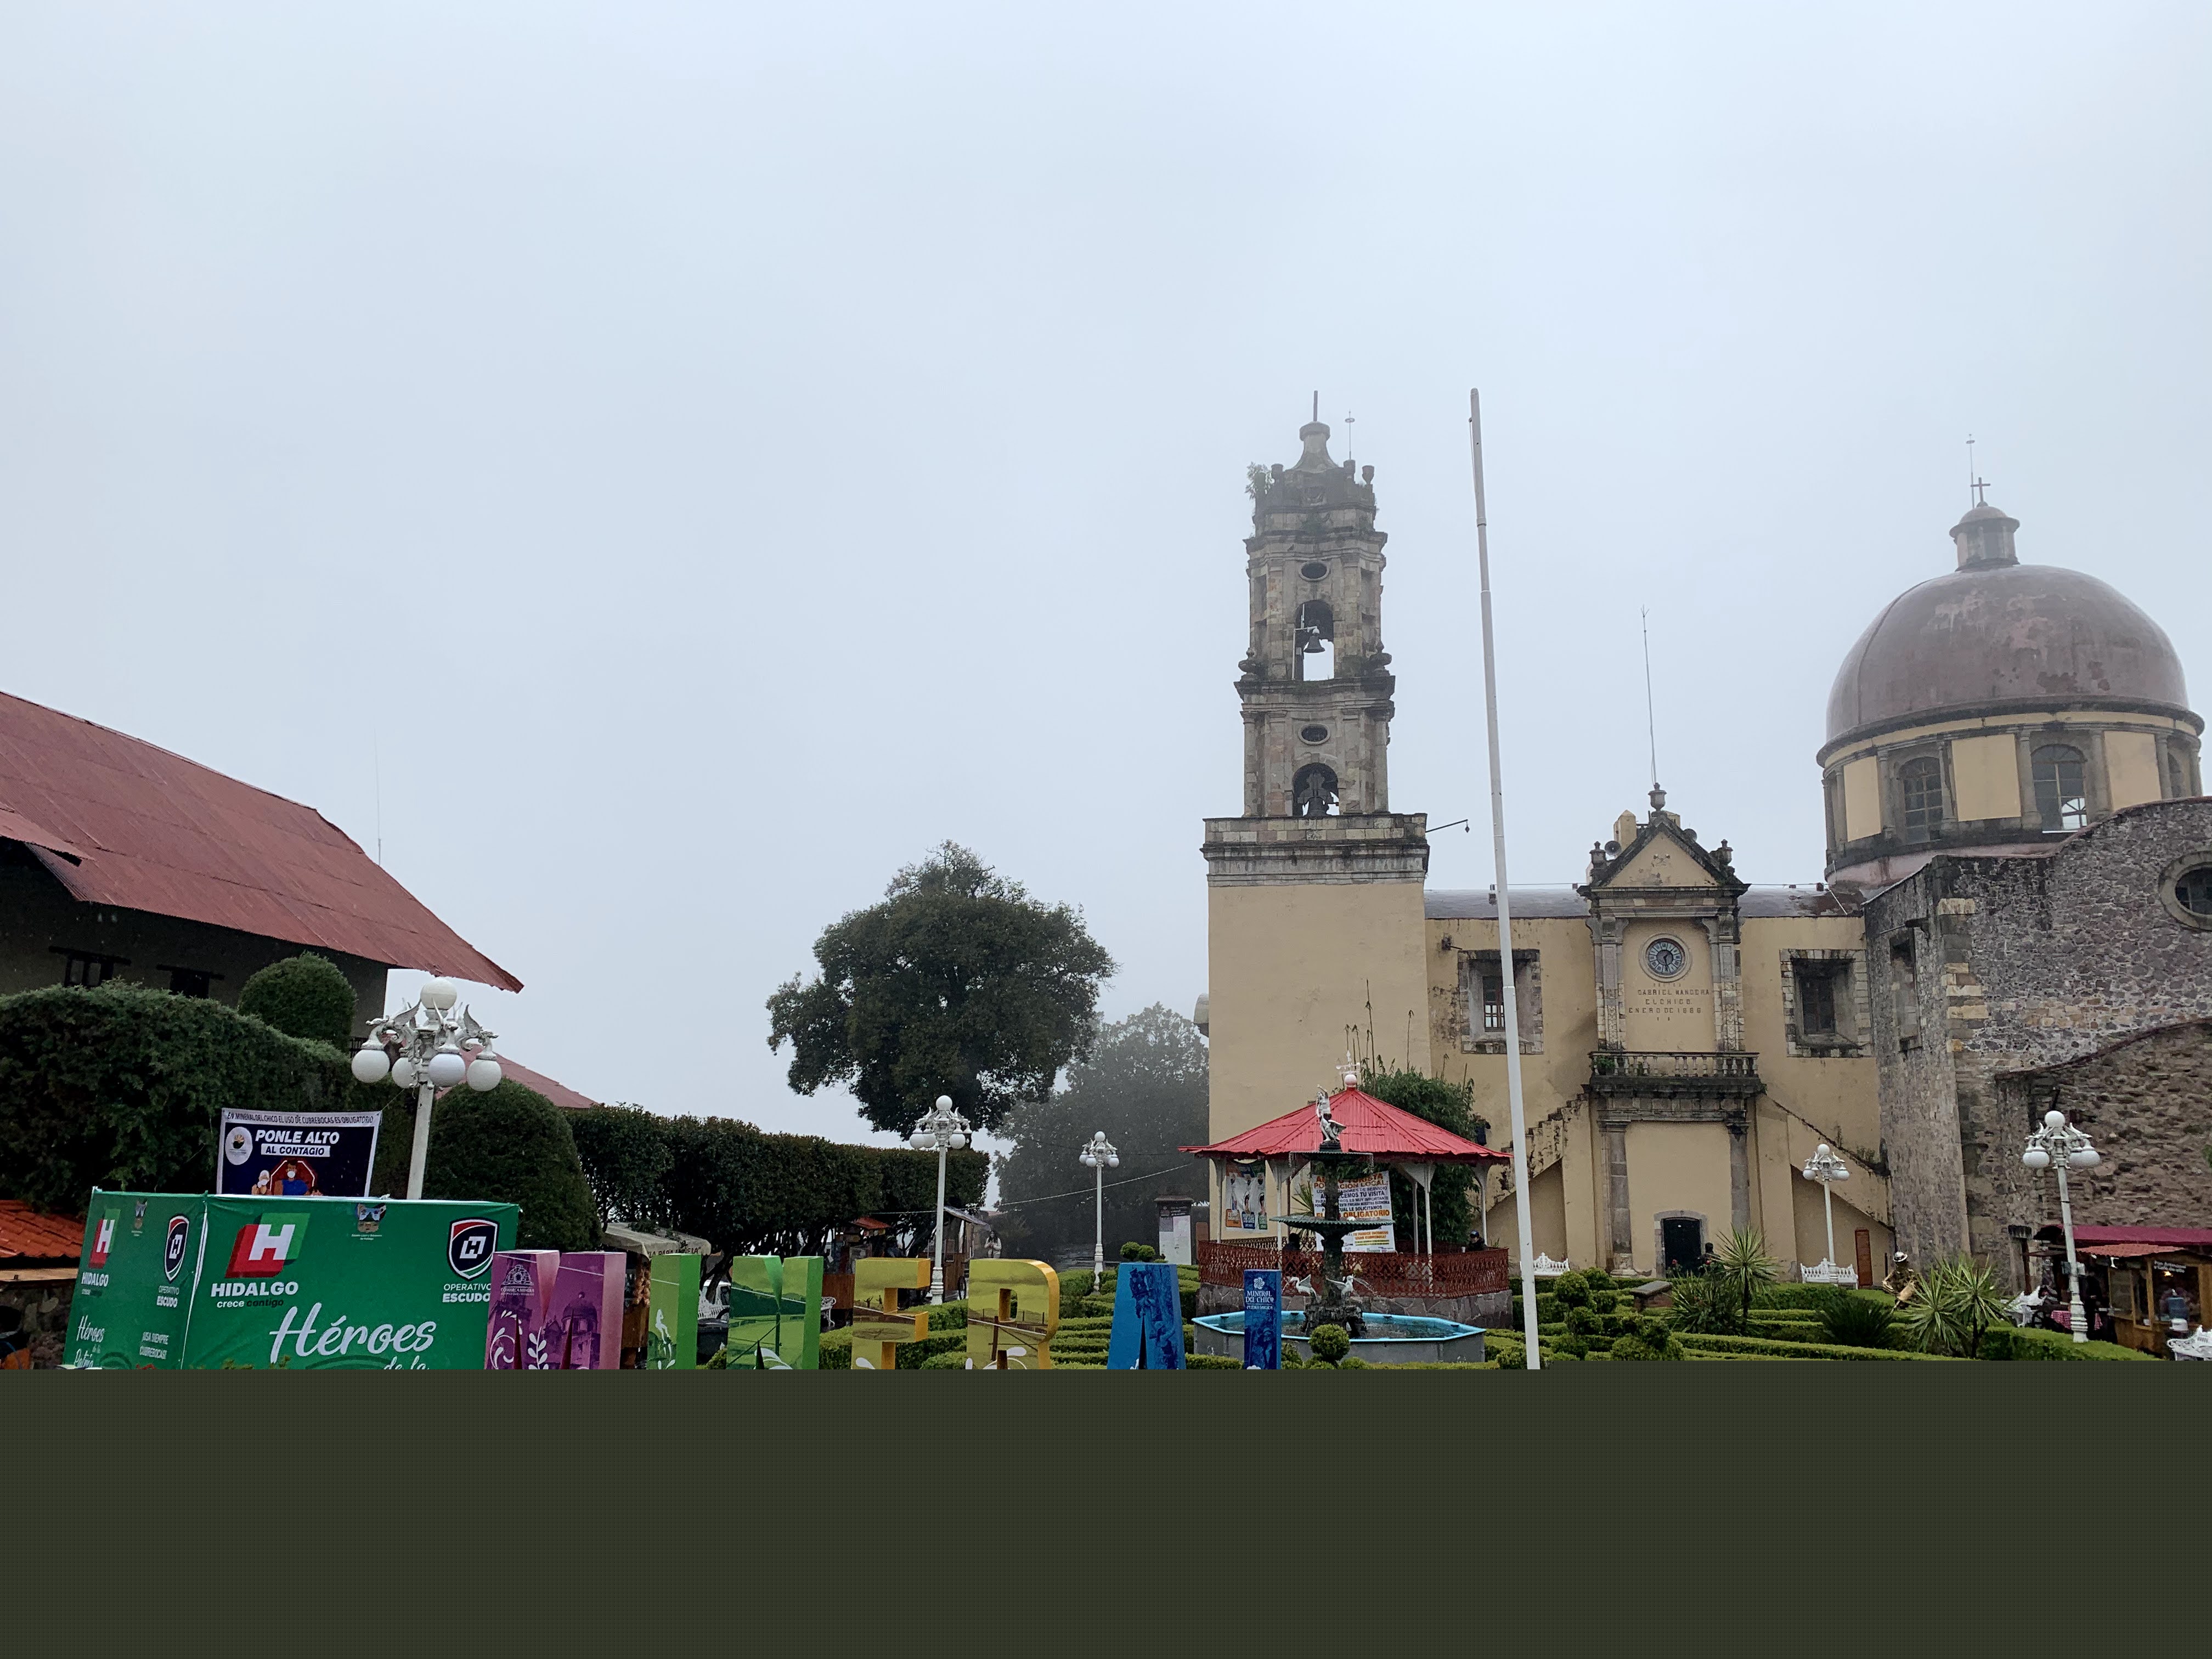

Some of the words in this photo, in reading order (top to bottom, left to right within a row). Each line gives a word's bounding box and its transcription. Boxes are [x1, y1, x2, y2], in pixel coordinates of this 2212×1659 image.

[255, 1130, 303, 1143] PONLE
[304, 1131, 340, 1144] ALTO
[279, 1147, 325, 1155] CONTAGIO
[81, 1272, 109, 1287] HIDALGO
[159, 1285, 179, 1295] OPERATIVO
[211, 1281, 299, 1297] HIDALGO
[156, 1296, 178, 1307] ESCUDO
[216, 1300, 245, 1308] crece
[246, 1298, 284, 1308] contigo
[442, 1293, 491, 1303] ESCUDO
[76, 1314, 105, 1342] Héroes
[269, 1302, 437, 1364] Héroes
